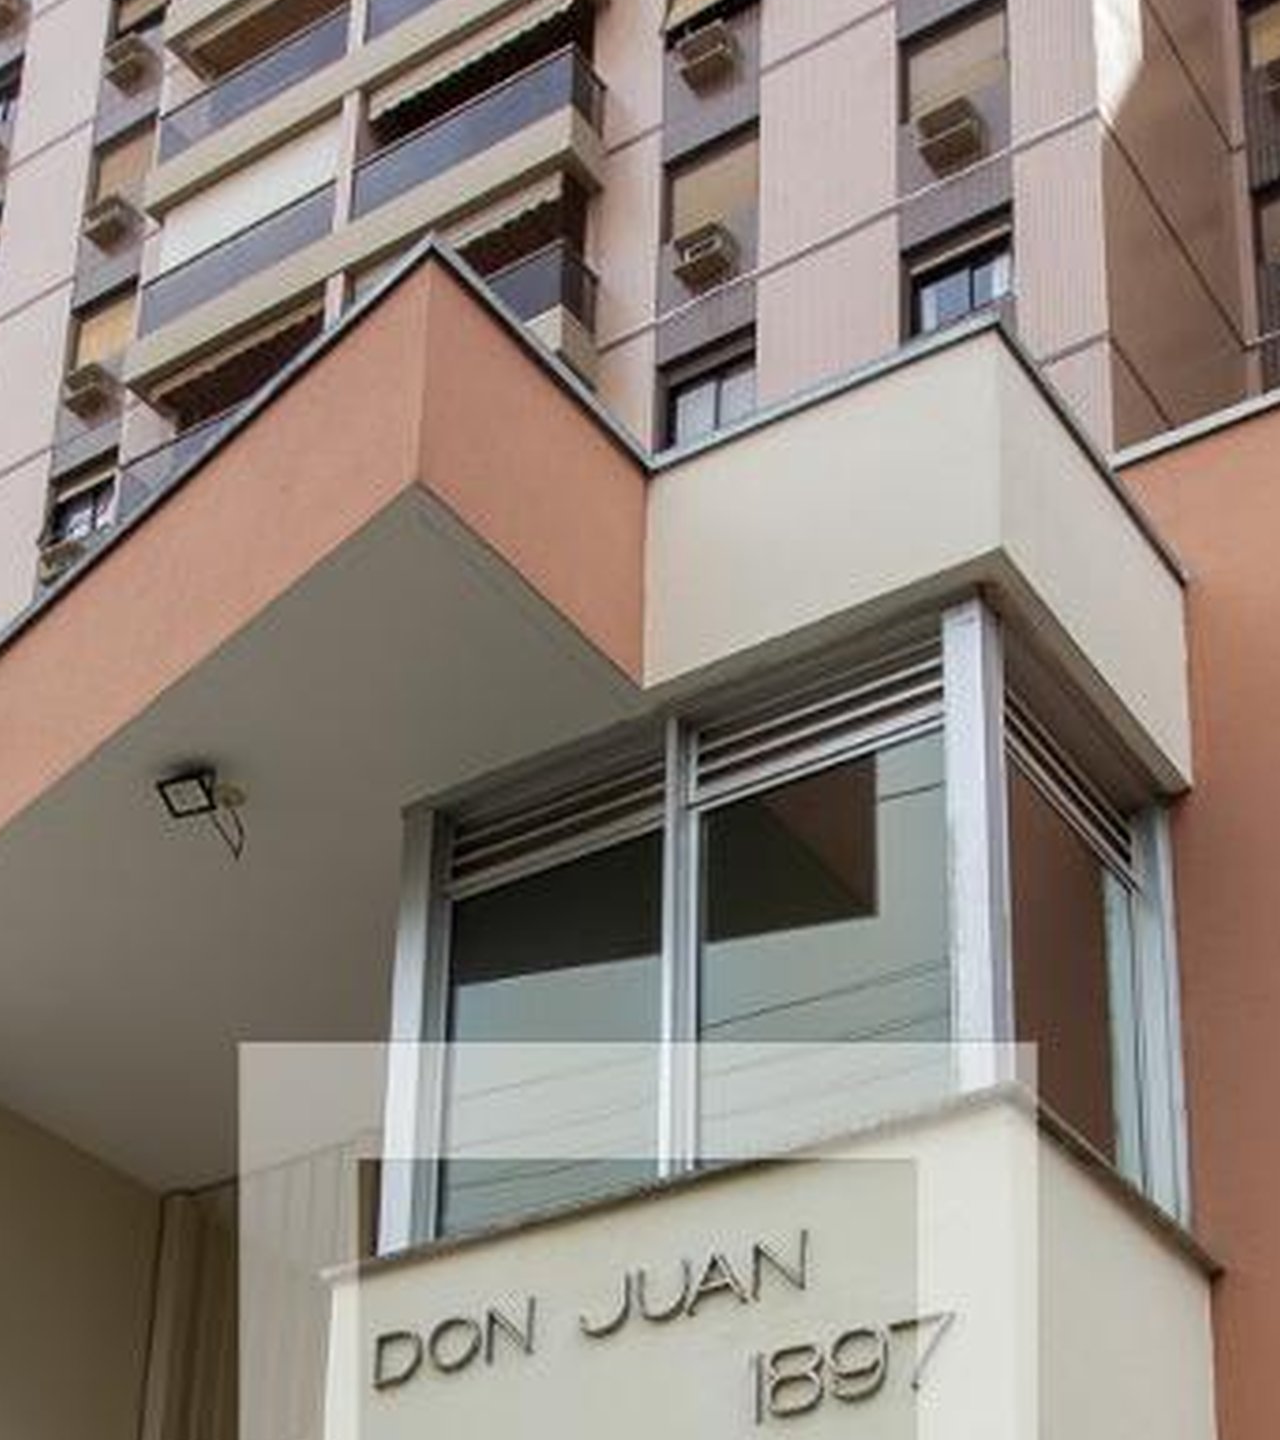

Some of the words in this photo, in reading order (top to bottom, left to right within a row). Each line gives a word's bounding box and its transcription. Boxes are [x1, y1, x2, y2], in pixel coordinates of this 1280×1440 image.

[373, 1297, 537, 1393] DON
[578, 1228, 809, 1339] JUAN
[753, 1310, 956, 1426] 1897
